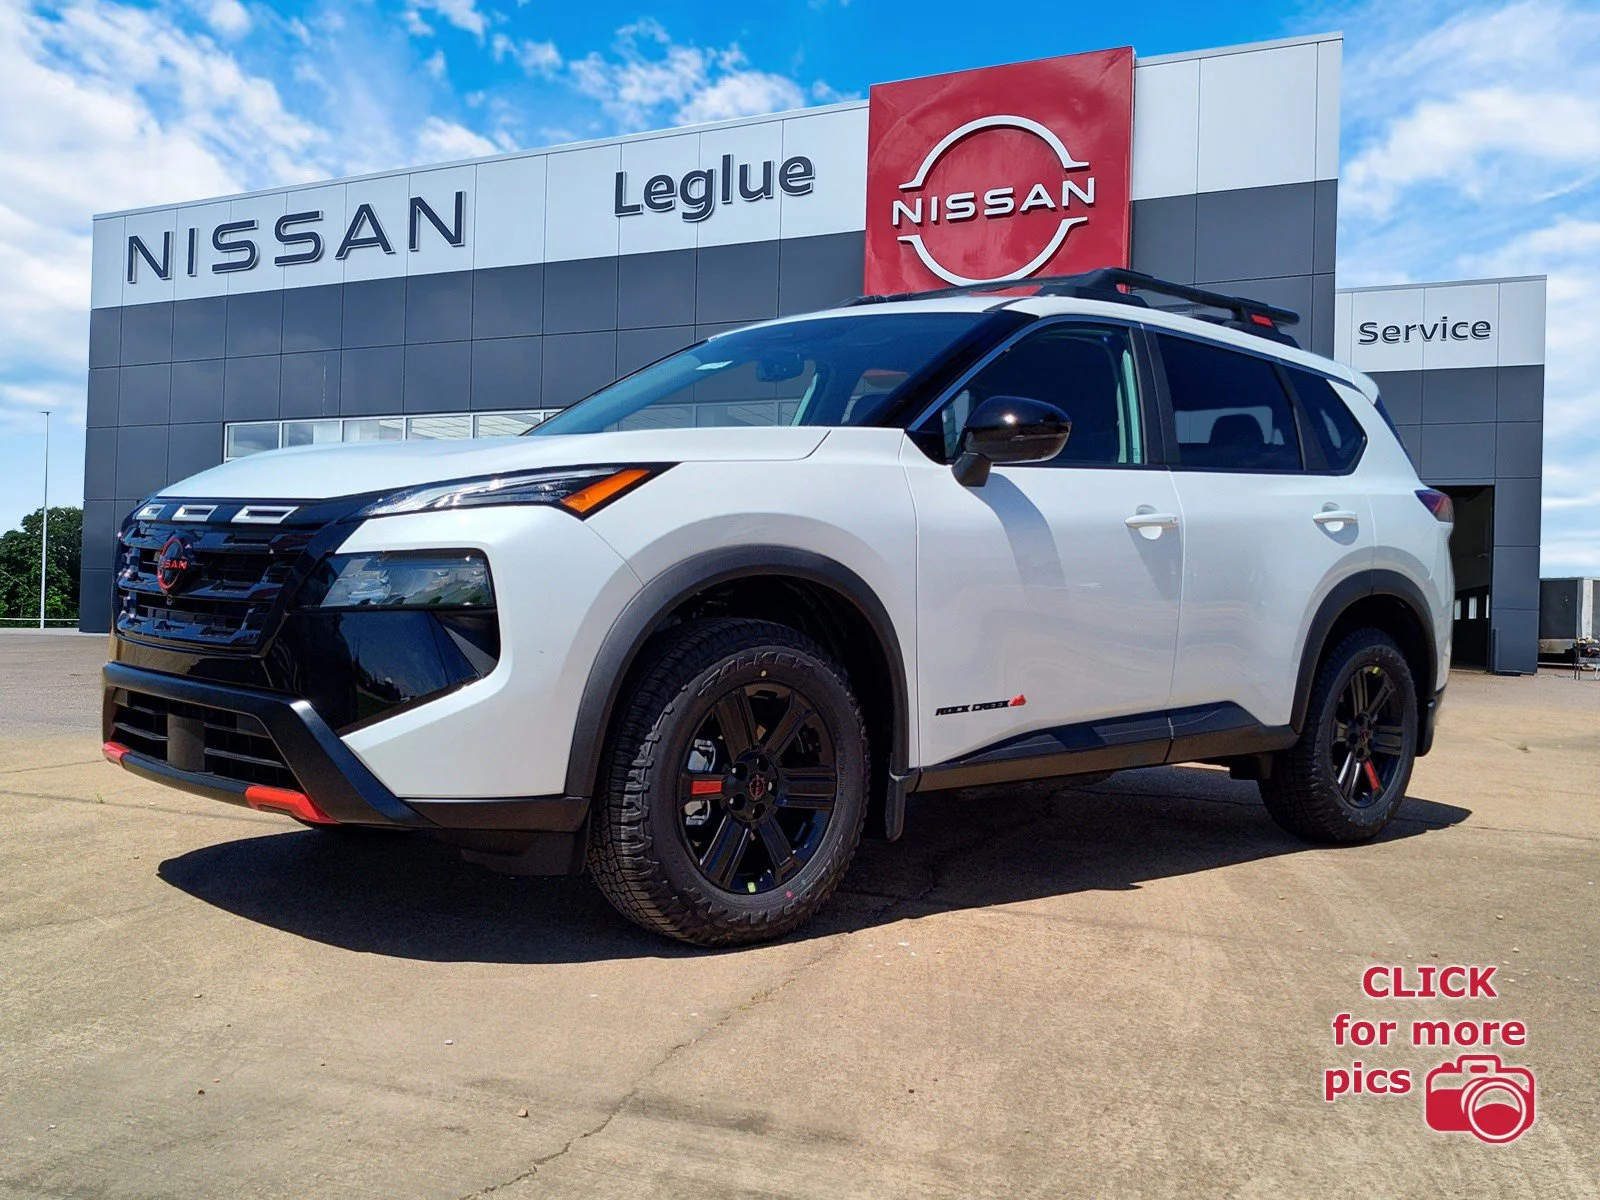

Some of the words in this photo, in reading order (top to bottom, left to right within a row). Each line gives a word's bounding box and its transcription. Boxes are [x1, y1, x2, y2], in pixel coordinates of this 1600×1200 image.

[614, 152, 816, 224] Leglue
[892, 177, 1096, 227] NISSAN
[127, 190, 466, 283] NISSAN
[1358, 315, 1492, 344] Service
[935, 704, 970, 717] ROCK
[971, 699, 1010, 712] CREEK
